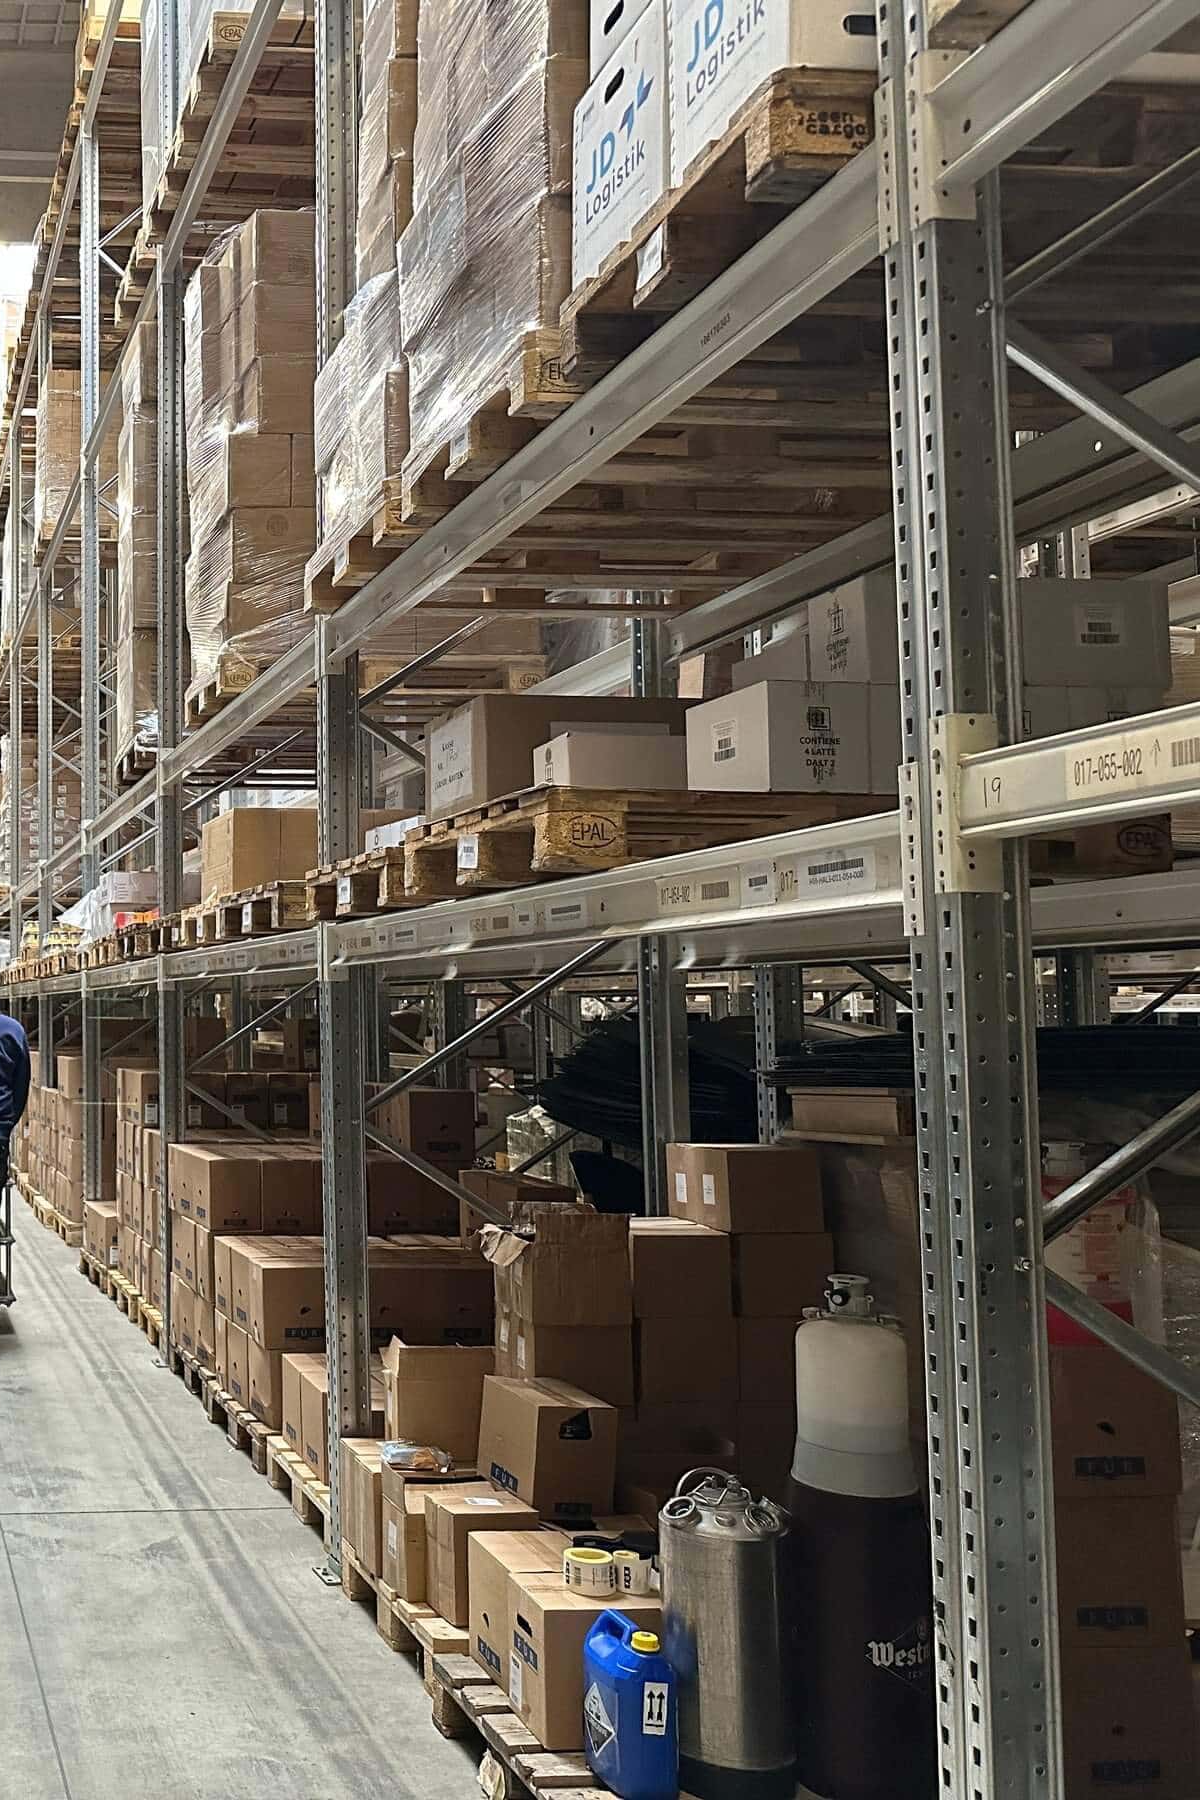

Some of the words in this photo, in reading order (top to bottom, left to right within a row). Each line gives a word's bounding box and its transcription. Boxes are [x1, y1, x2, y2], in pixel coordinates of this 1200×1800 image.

[687, 0, 724, 73] JD
[687, 3, 766, 108] Logistik
[585, 139, 646, 225] Logistik
[586, 131, 616, 194] JD
[799, 736, 841, 745] CONTIENE
[811, 747, 836, 756] LATTE
[1074, 748, 1143, 787] 017-055-002
[571, 822, 611, 842] EPAL
